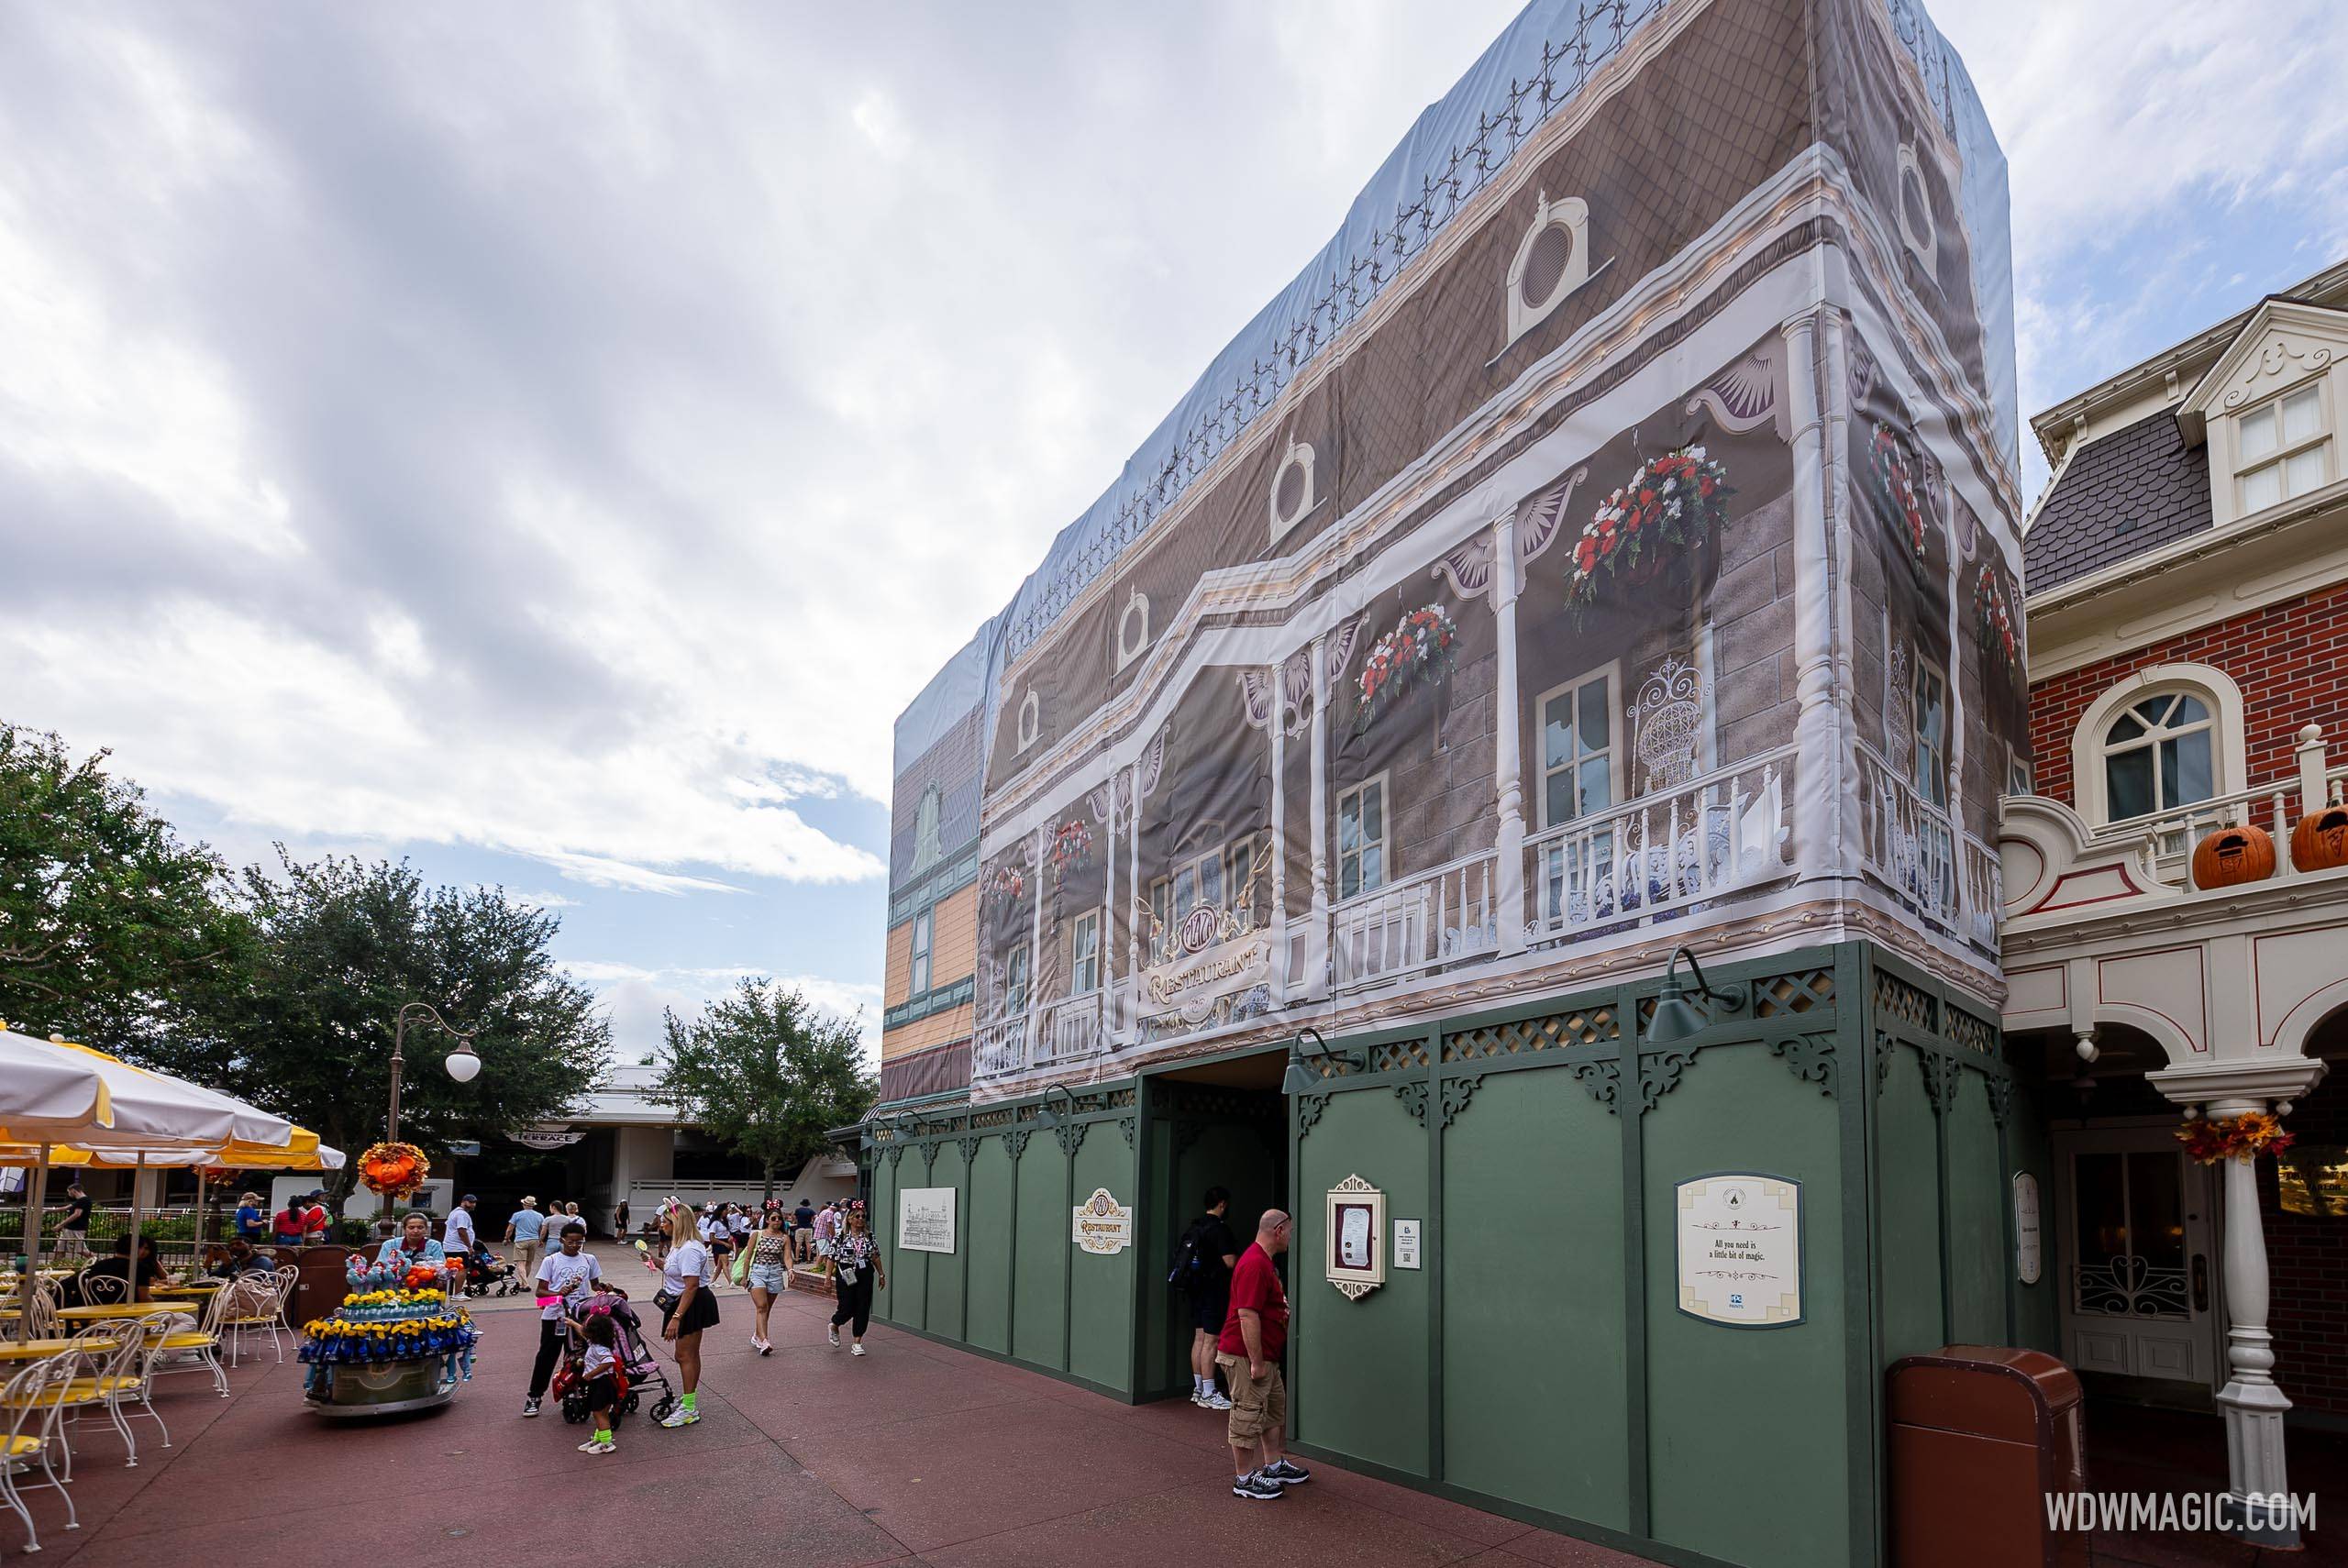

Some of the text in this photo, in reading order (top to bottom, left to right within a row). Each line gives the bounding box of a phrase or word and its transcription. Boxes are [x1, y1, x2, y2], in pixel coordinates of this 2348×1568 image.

[1185, 911, 1213, 948] PLAZA
[1149, 949, 1257, 1005] RESTAURANT
[1080, 1220, 1121, 1235] RESTAURANT
[1714, 1240, 1723, 1248] All
[1735, 1240, 1749, 1249] need
[1750, 1240, 1756, 1249] is
[1714, 1250, 1728, 1259] little
[1729, 1251, 1737, 1259] bit
[1738, 1251, 1744, 1259] of
[1745, 1252, 1765, 1262] magic.
